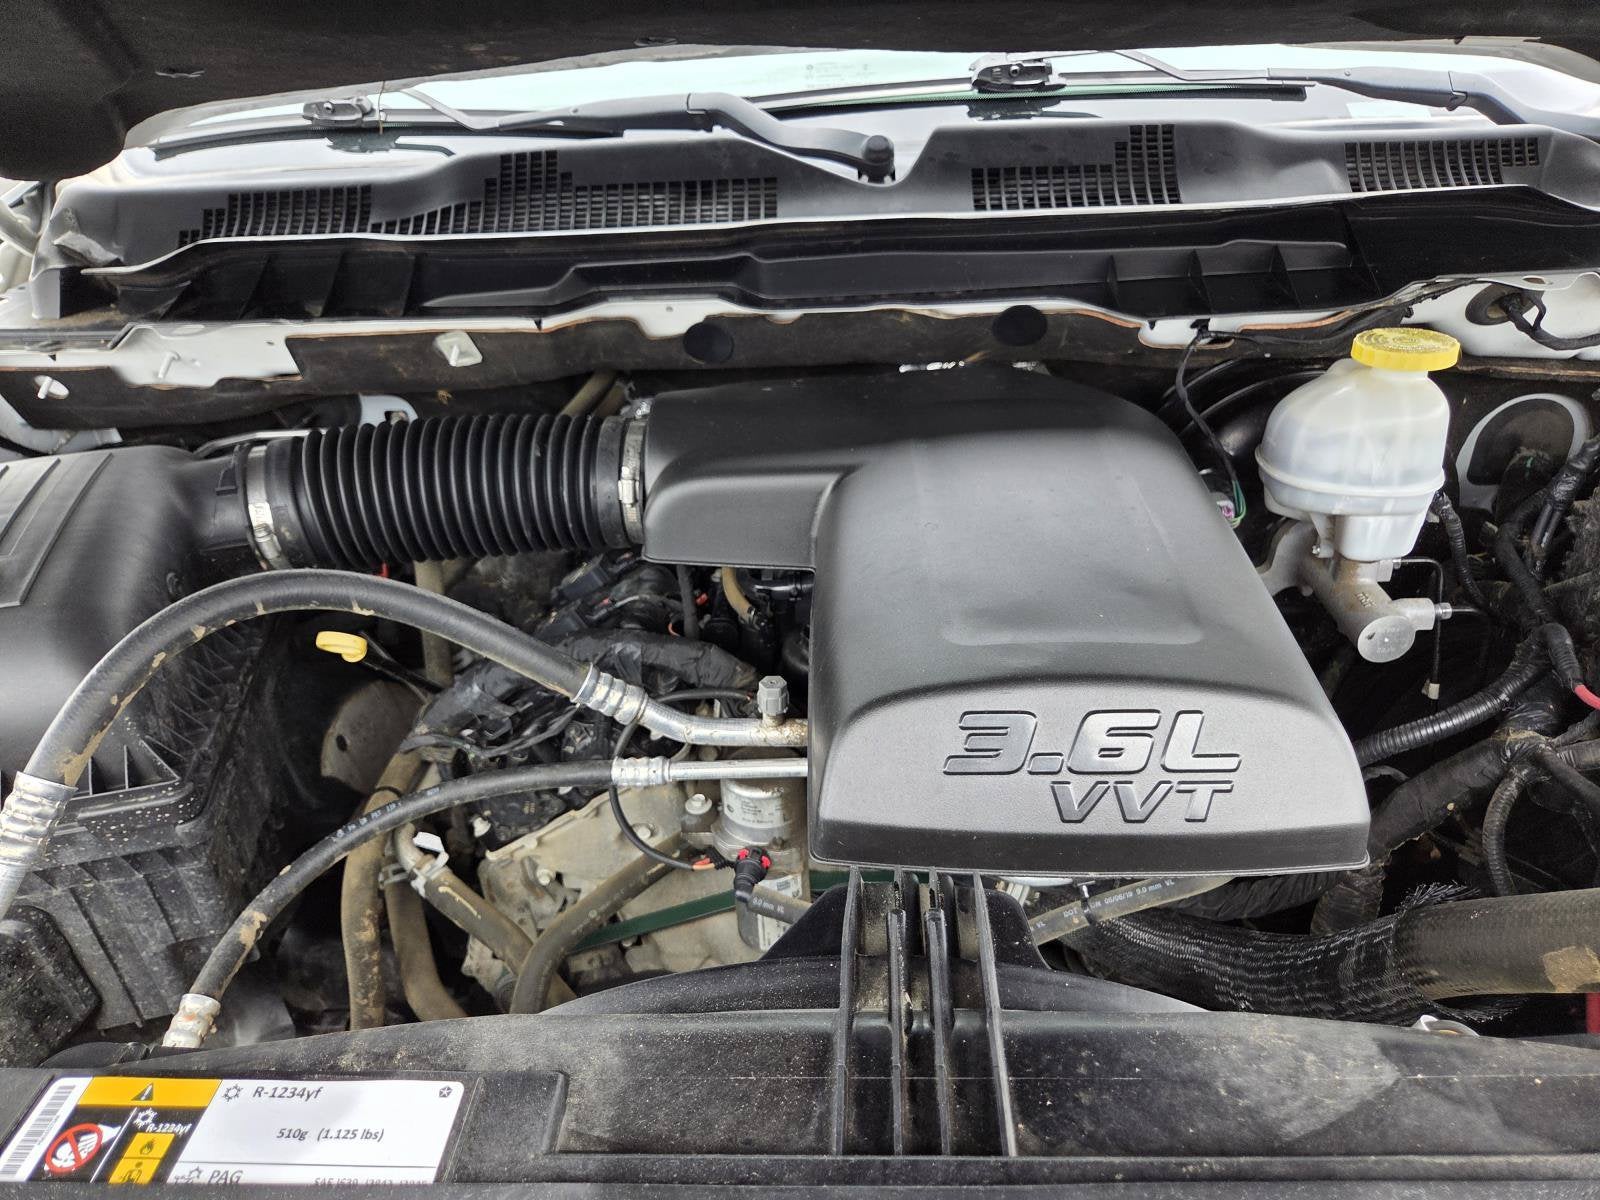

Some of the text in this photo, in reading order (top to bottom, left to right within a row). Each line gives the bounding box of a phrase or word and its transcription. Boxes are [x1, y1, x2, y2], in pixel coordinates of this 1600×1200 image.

[943, 709, 1242, 775] 3.6L
[1050, 780, 1234, 824] VVT
[252, 1086, 324, 1102] R-1234yf
[145, 1123, 193, 1138] R-1234yf
[276, 1128, 385, 1143] 510g (1.125 lbs)
[208, 1170, 243, 1184] PAG
